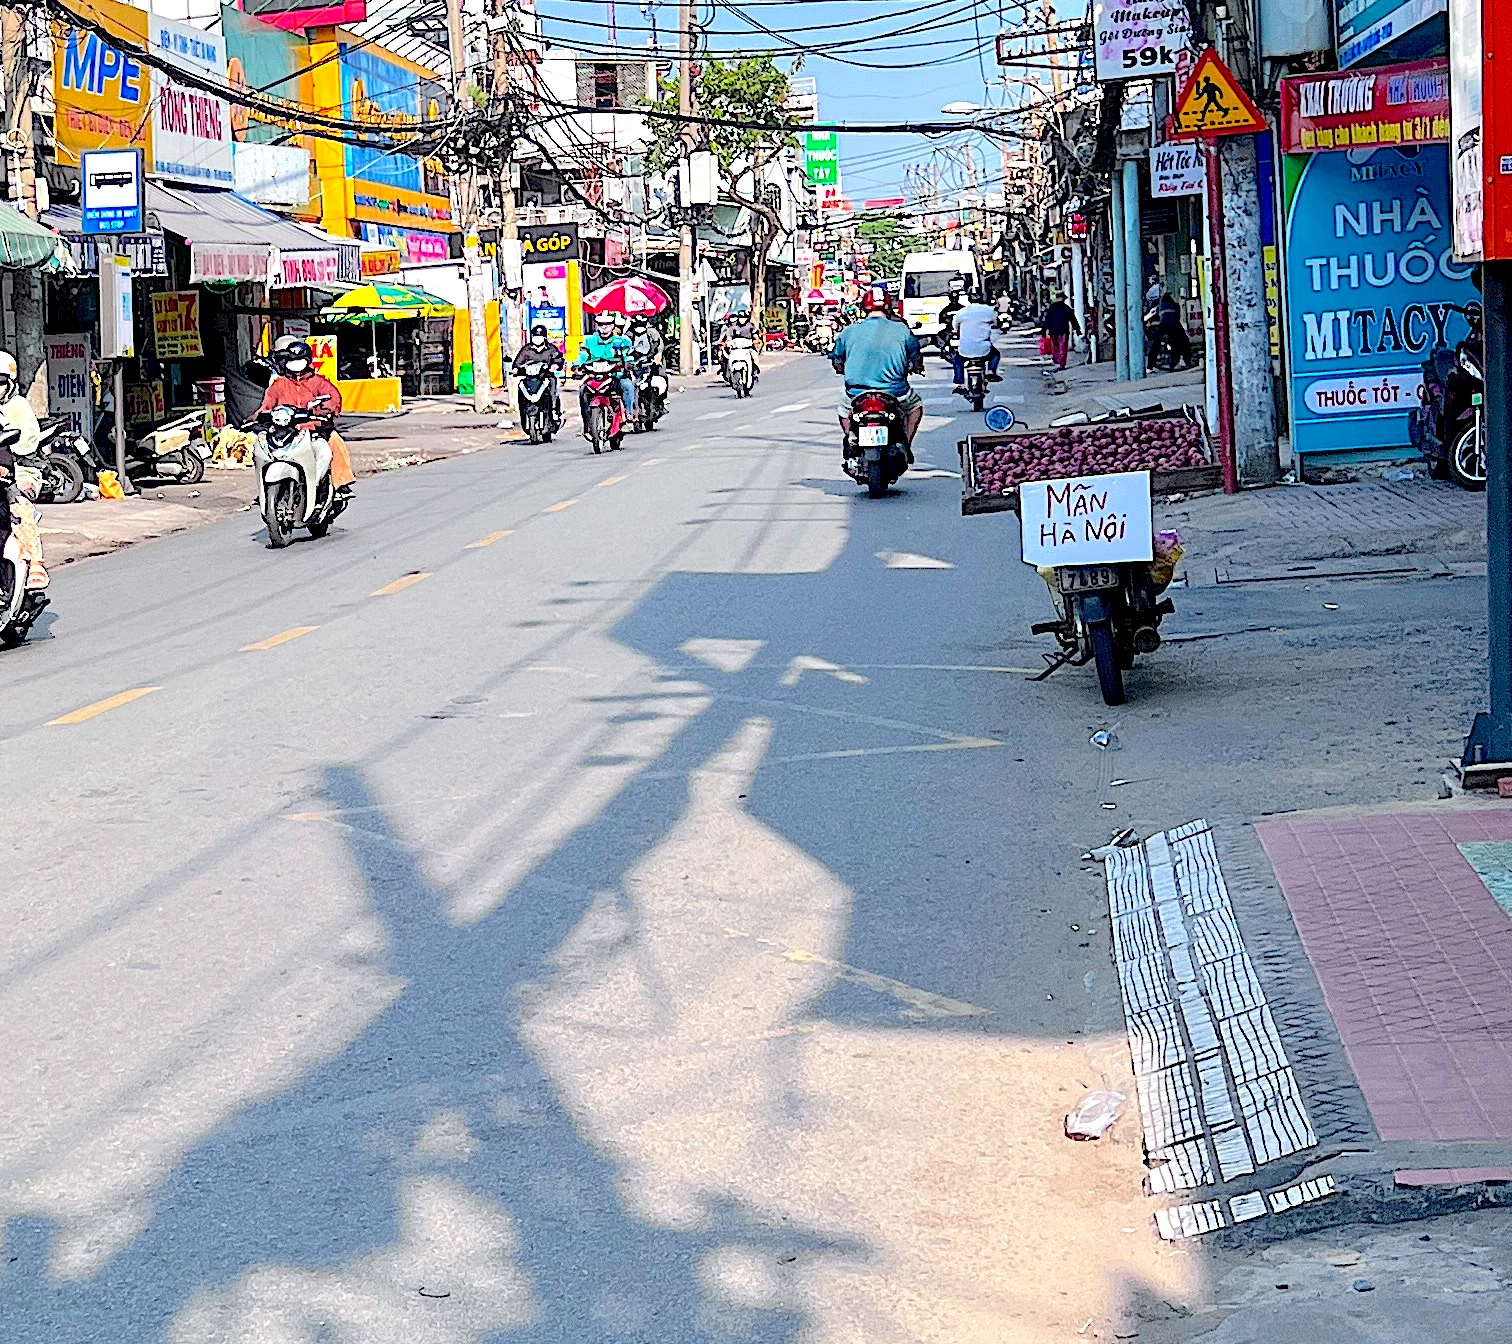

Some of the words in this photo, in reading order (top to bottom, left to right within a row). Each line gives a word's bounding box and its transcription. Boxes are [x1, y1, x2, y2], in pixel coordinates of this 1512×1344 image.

[62, 25, 141, 105] MPE
[1122, 45, 1176, 69] 59k
[1299, 80, 1326, 118] KHAI
[1414, 115, 1430, 140] 3/1
[1333, 187, 1443, 238] NHÀ
[536, 230, 572, 251] GÓP
[1304, 234, 1476, 292] THUỐC
[1302, 300, 1456, 361] MITACY
[57, 368, 86, 404] ĐIỆN
[1315, 380, 1367, 408] THUỐC
[1371, 377, 1400, 403] TỐT
